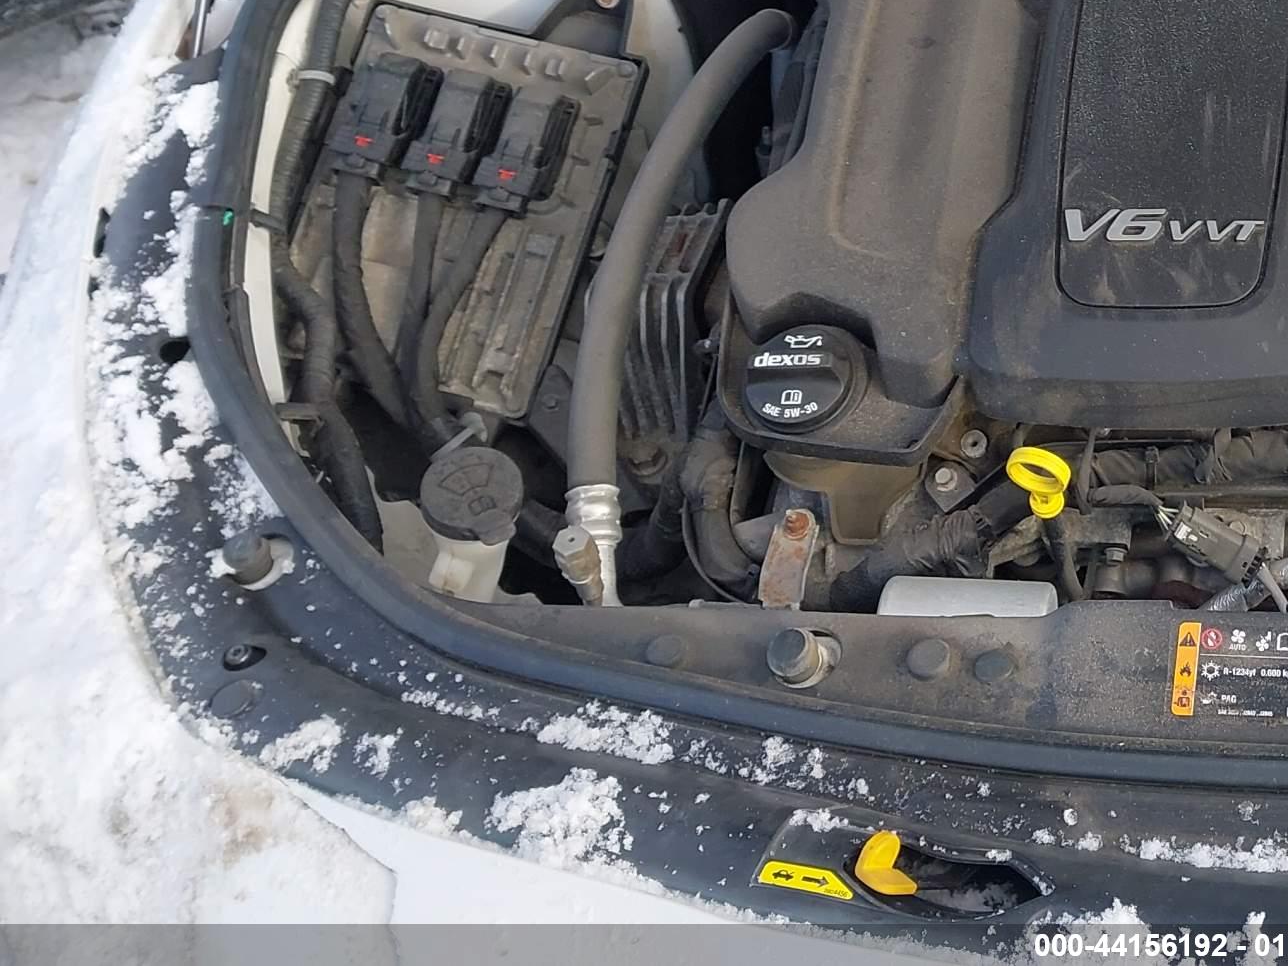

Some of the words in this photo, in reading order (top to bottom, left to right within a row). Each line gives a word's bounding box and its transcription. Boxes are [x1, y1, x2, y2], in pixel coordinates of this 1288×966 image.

[1064, 208, 1168, 242] V6
[1169, 220, 1265, 242] VVT
[753, 352, 825, 368] dexos
[762, 402, 782, 417] SAE
[783, 401, 818, 418] 5W-30
[1228, 643, 1247, 651] AUTO
[1223, 666, 1256, 678] R-1234yf
[1221, 694, 1237, 703] PAG
